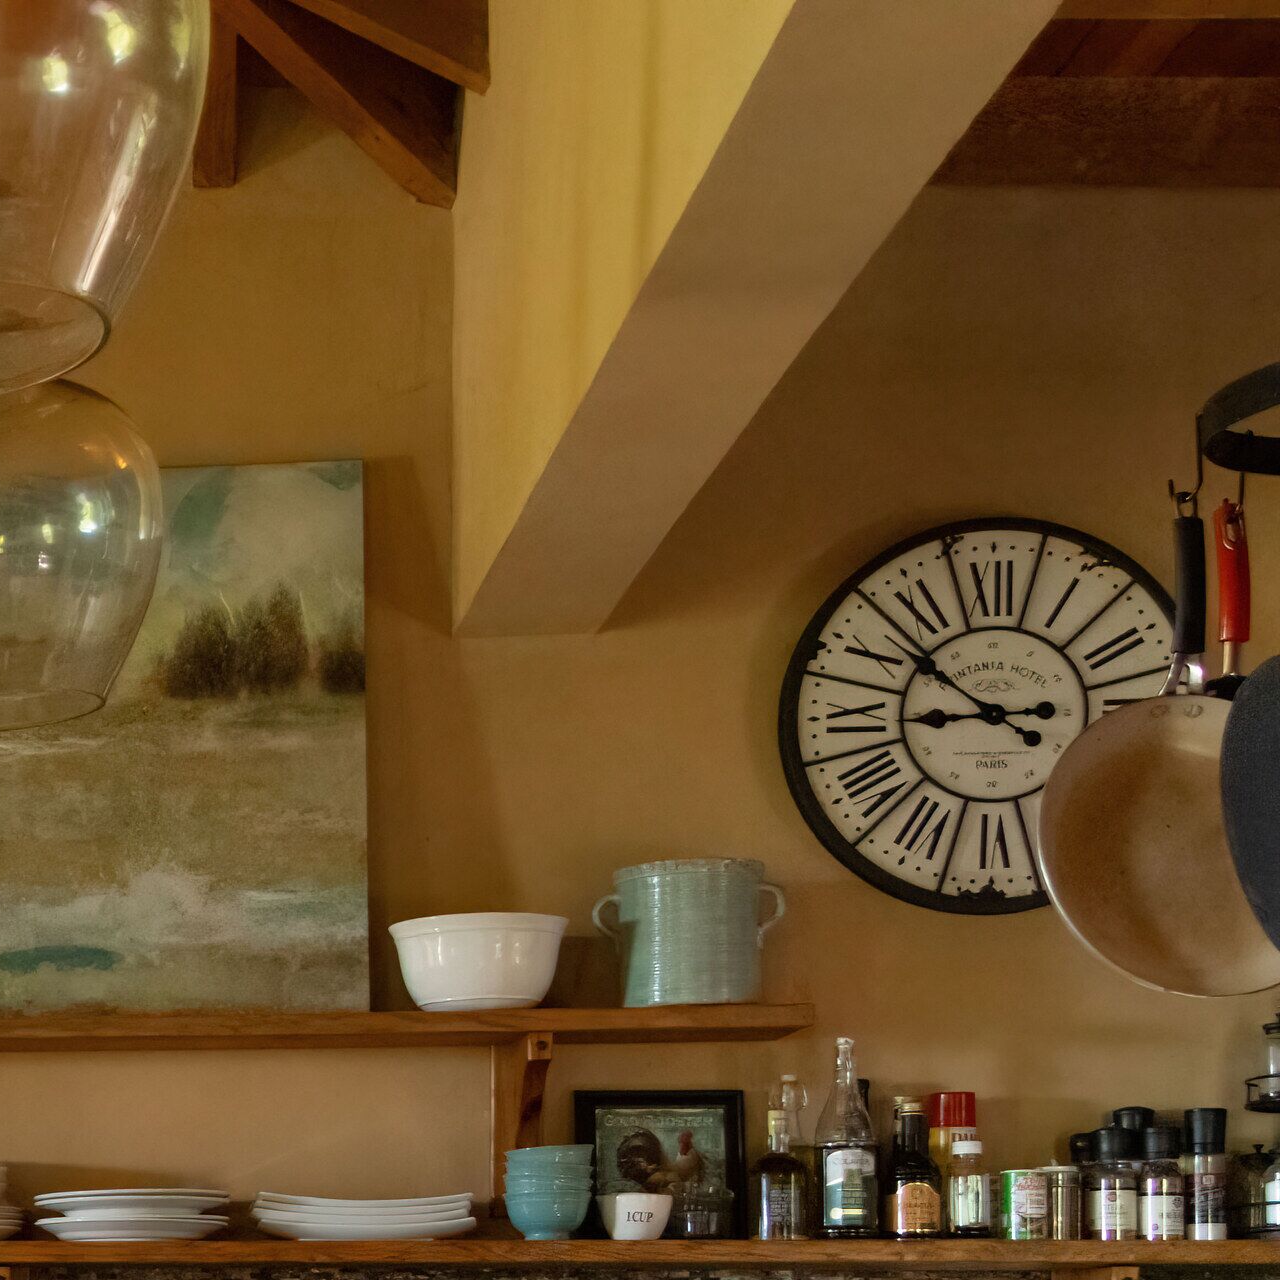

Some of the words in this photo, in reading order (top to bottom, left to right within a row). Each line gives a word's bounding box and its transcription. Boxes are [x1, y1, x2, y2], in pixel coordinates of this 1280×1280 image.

[893, 578, 951, 641] XI
[969, 560, 1014, 618] XII
[1010, 664, 1048, 689] HOTEL
[826, 702, 887, 733] IX
[837, 750, 909, 819] VIII
[975, 759, 1009, 769] PARIS
[893, 795, 951, 860] VII
[979, 813, 1011, 869] VI
